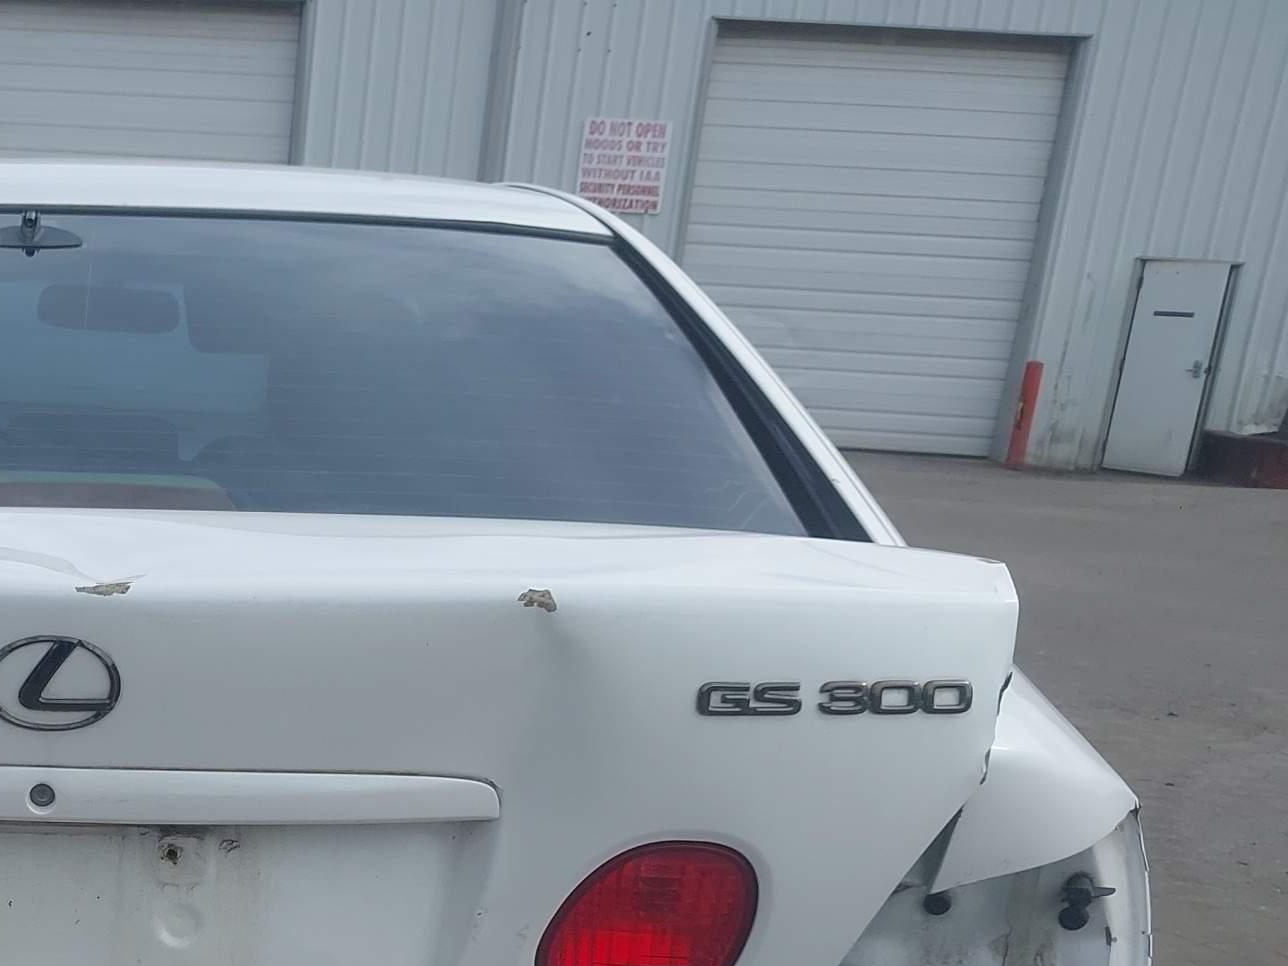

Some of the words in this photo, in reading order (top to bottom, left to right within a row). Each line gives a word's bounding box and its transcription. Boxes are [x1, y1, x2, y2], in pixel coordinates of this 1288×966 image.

[589, 120, 606, 136] DO
[608, 121, 632, 138] NOT
[636, 122, 666, 139] OPEN
[626, 140, 642, 153] OR
[646, 141, 667, 153] TRY
[596, 154, 625, 166] START
[581, 167, 636, 180] WITHOUT
[696, 681, 802, 716] GS
[818, 680, 973, 715] 300
